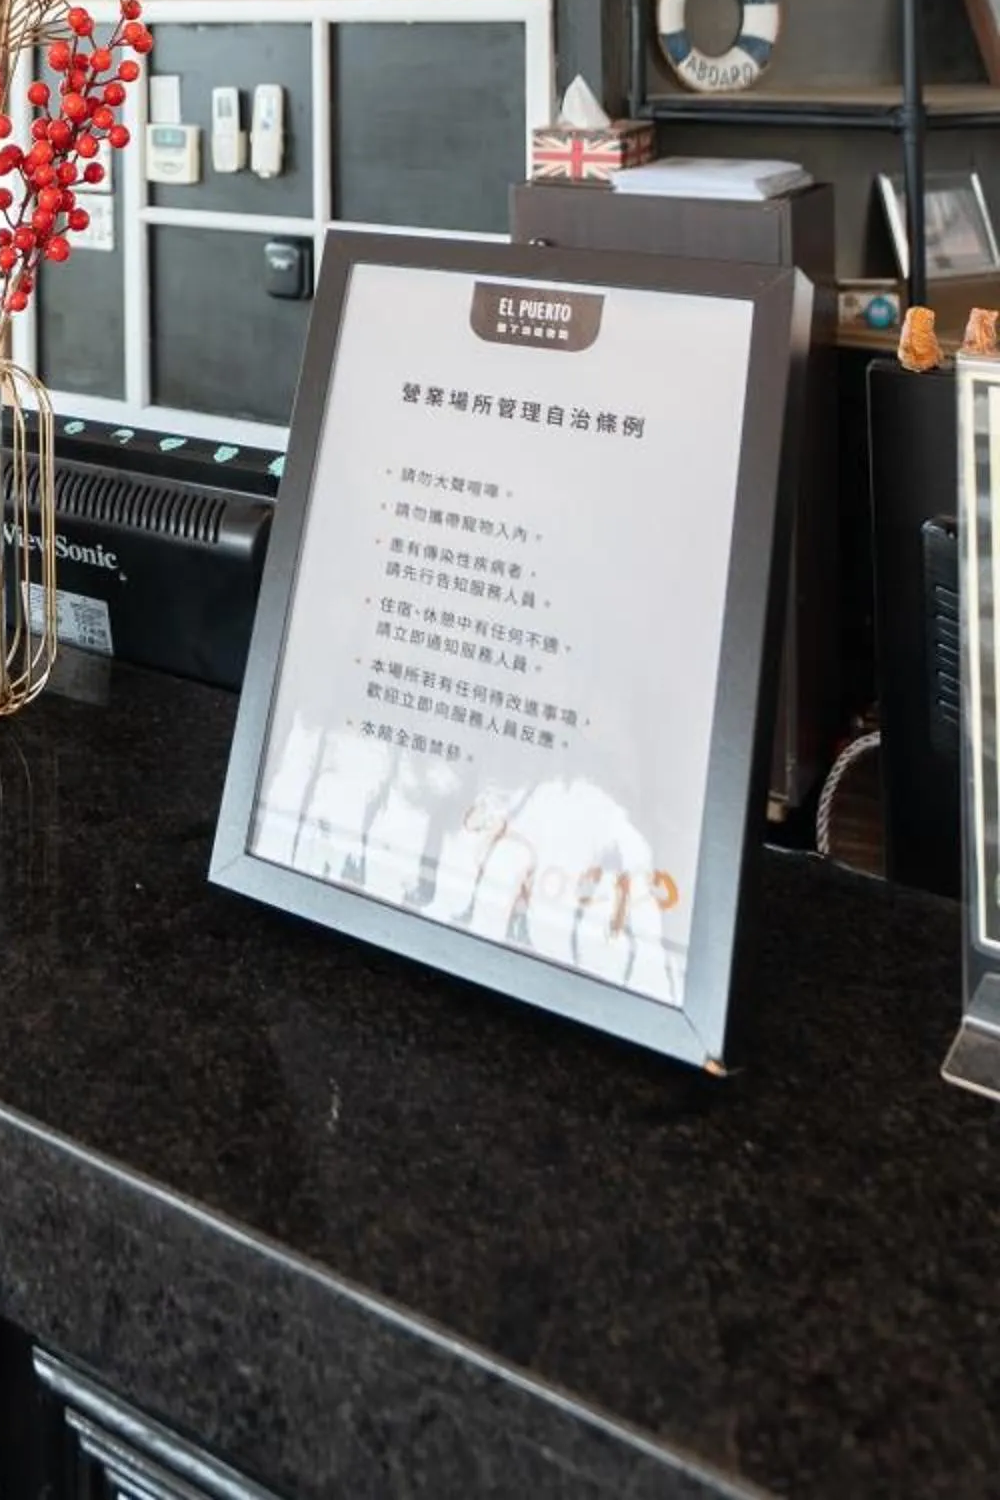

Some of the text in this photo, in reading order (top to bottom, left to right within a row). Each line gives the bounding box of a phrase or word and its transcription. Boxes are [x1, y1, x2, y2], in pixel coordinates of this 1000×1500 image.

[499, 297, 572, 322] EL PUERTO
[402, 382, 646, 439] 營業場所管理自治條例
